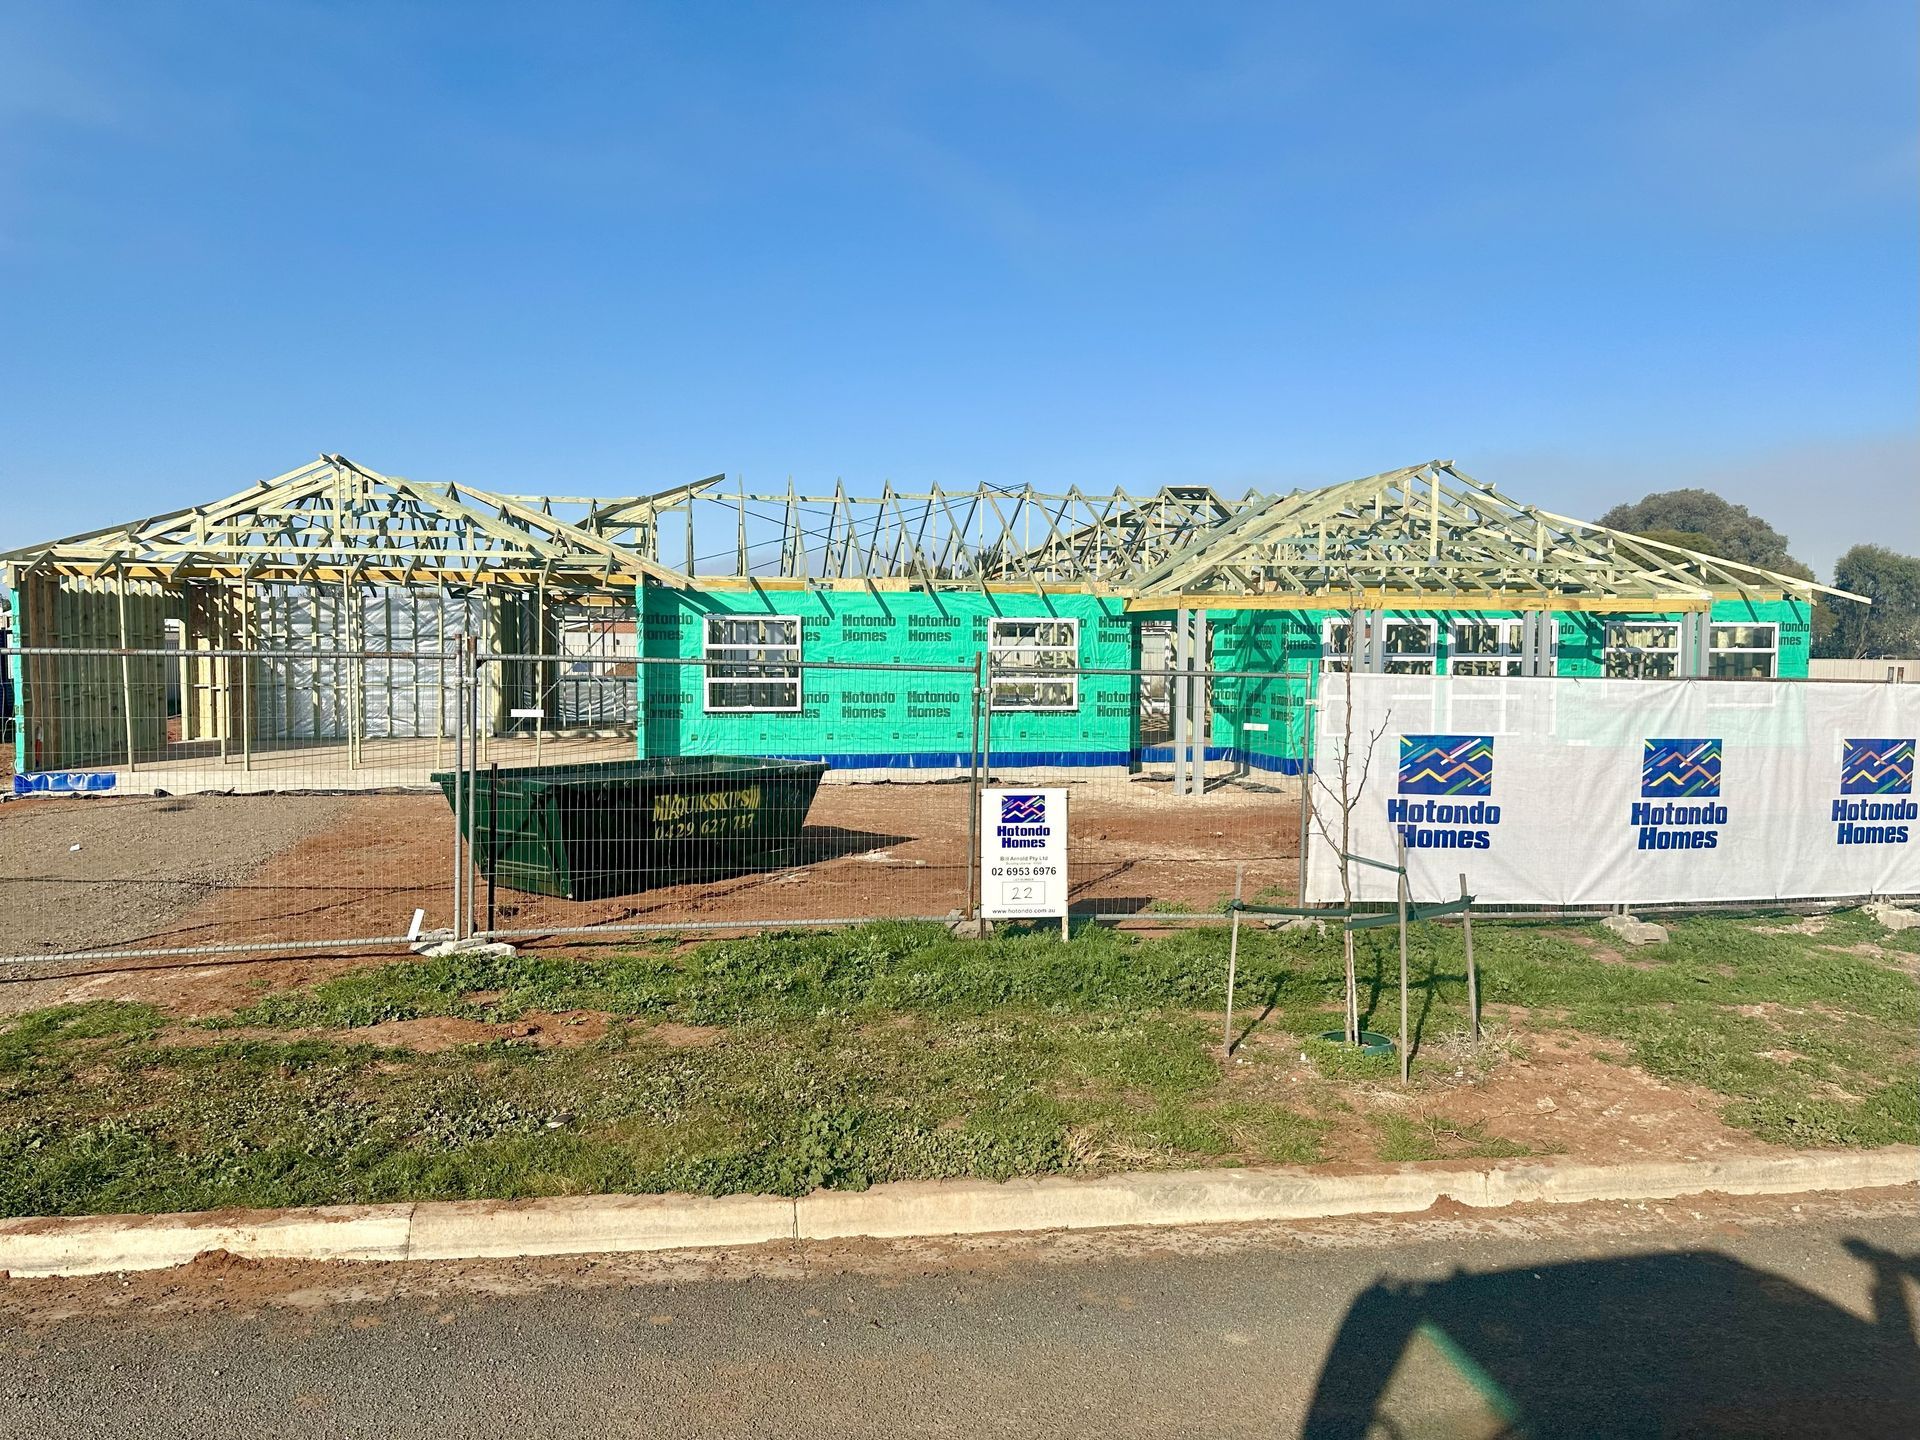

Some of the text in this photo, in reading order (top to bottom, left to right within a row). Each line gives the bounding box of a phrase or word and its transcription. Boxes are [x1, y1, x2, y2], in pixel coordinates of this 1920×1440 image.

[842, 614, 897, 627] Hotondo
[908, 615, 961, 627] Hotondo
[842, 630, 887, 641] Homes
[908, 630, 952, 642] Homes
[841, 691, 896, 703] Hotondo
[907, 691, 960, 703] Hotondo
[841, 706, 887, 718] Homes
[907, 706, 951, 718] Homes
[1388, 799, 1500, 824] Hotondo
[1631, 802, 1728, 825] Hotondo
[1832, 799, 1918, 821] Hotondo
[997, 825, 1050, 836] Hotondo
[1837, 823, 1909, 844] Homes
[1001, 838, 1046, 848] Homes
[1397, 825, 1490, 849] Homes
[1638, 827, 1718, 850] Homes
[991, 867, 1057, 876] 02 6953 6976
[1011, 886, 1033, 900] 22
